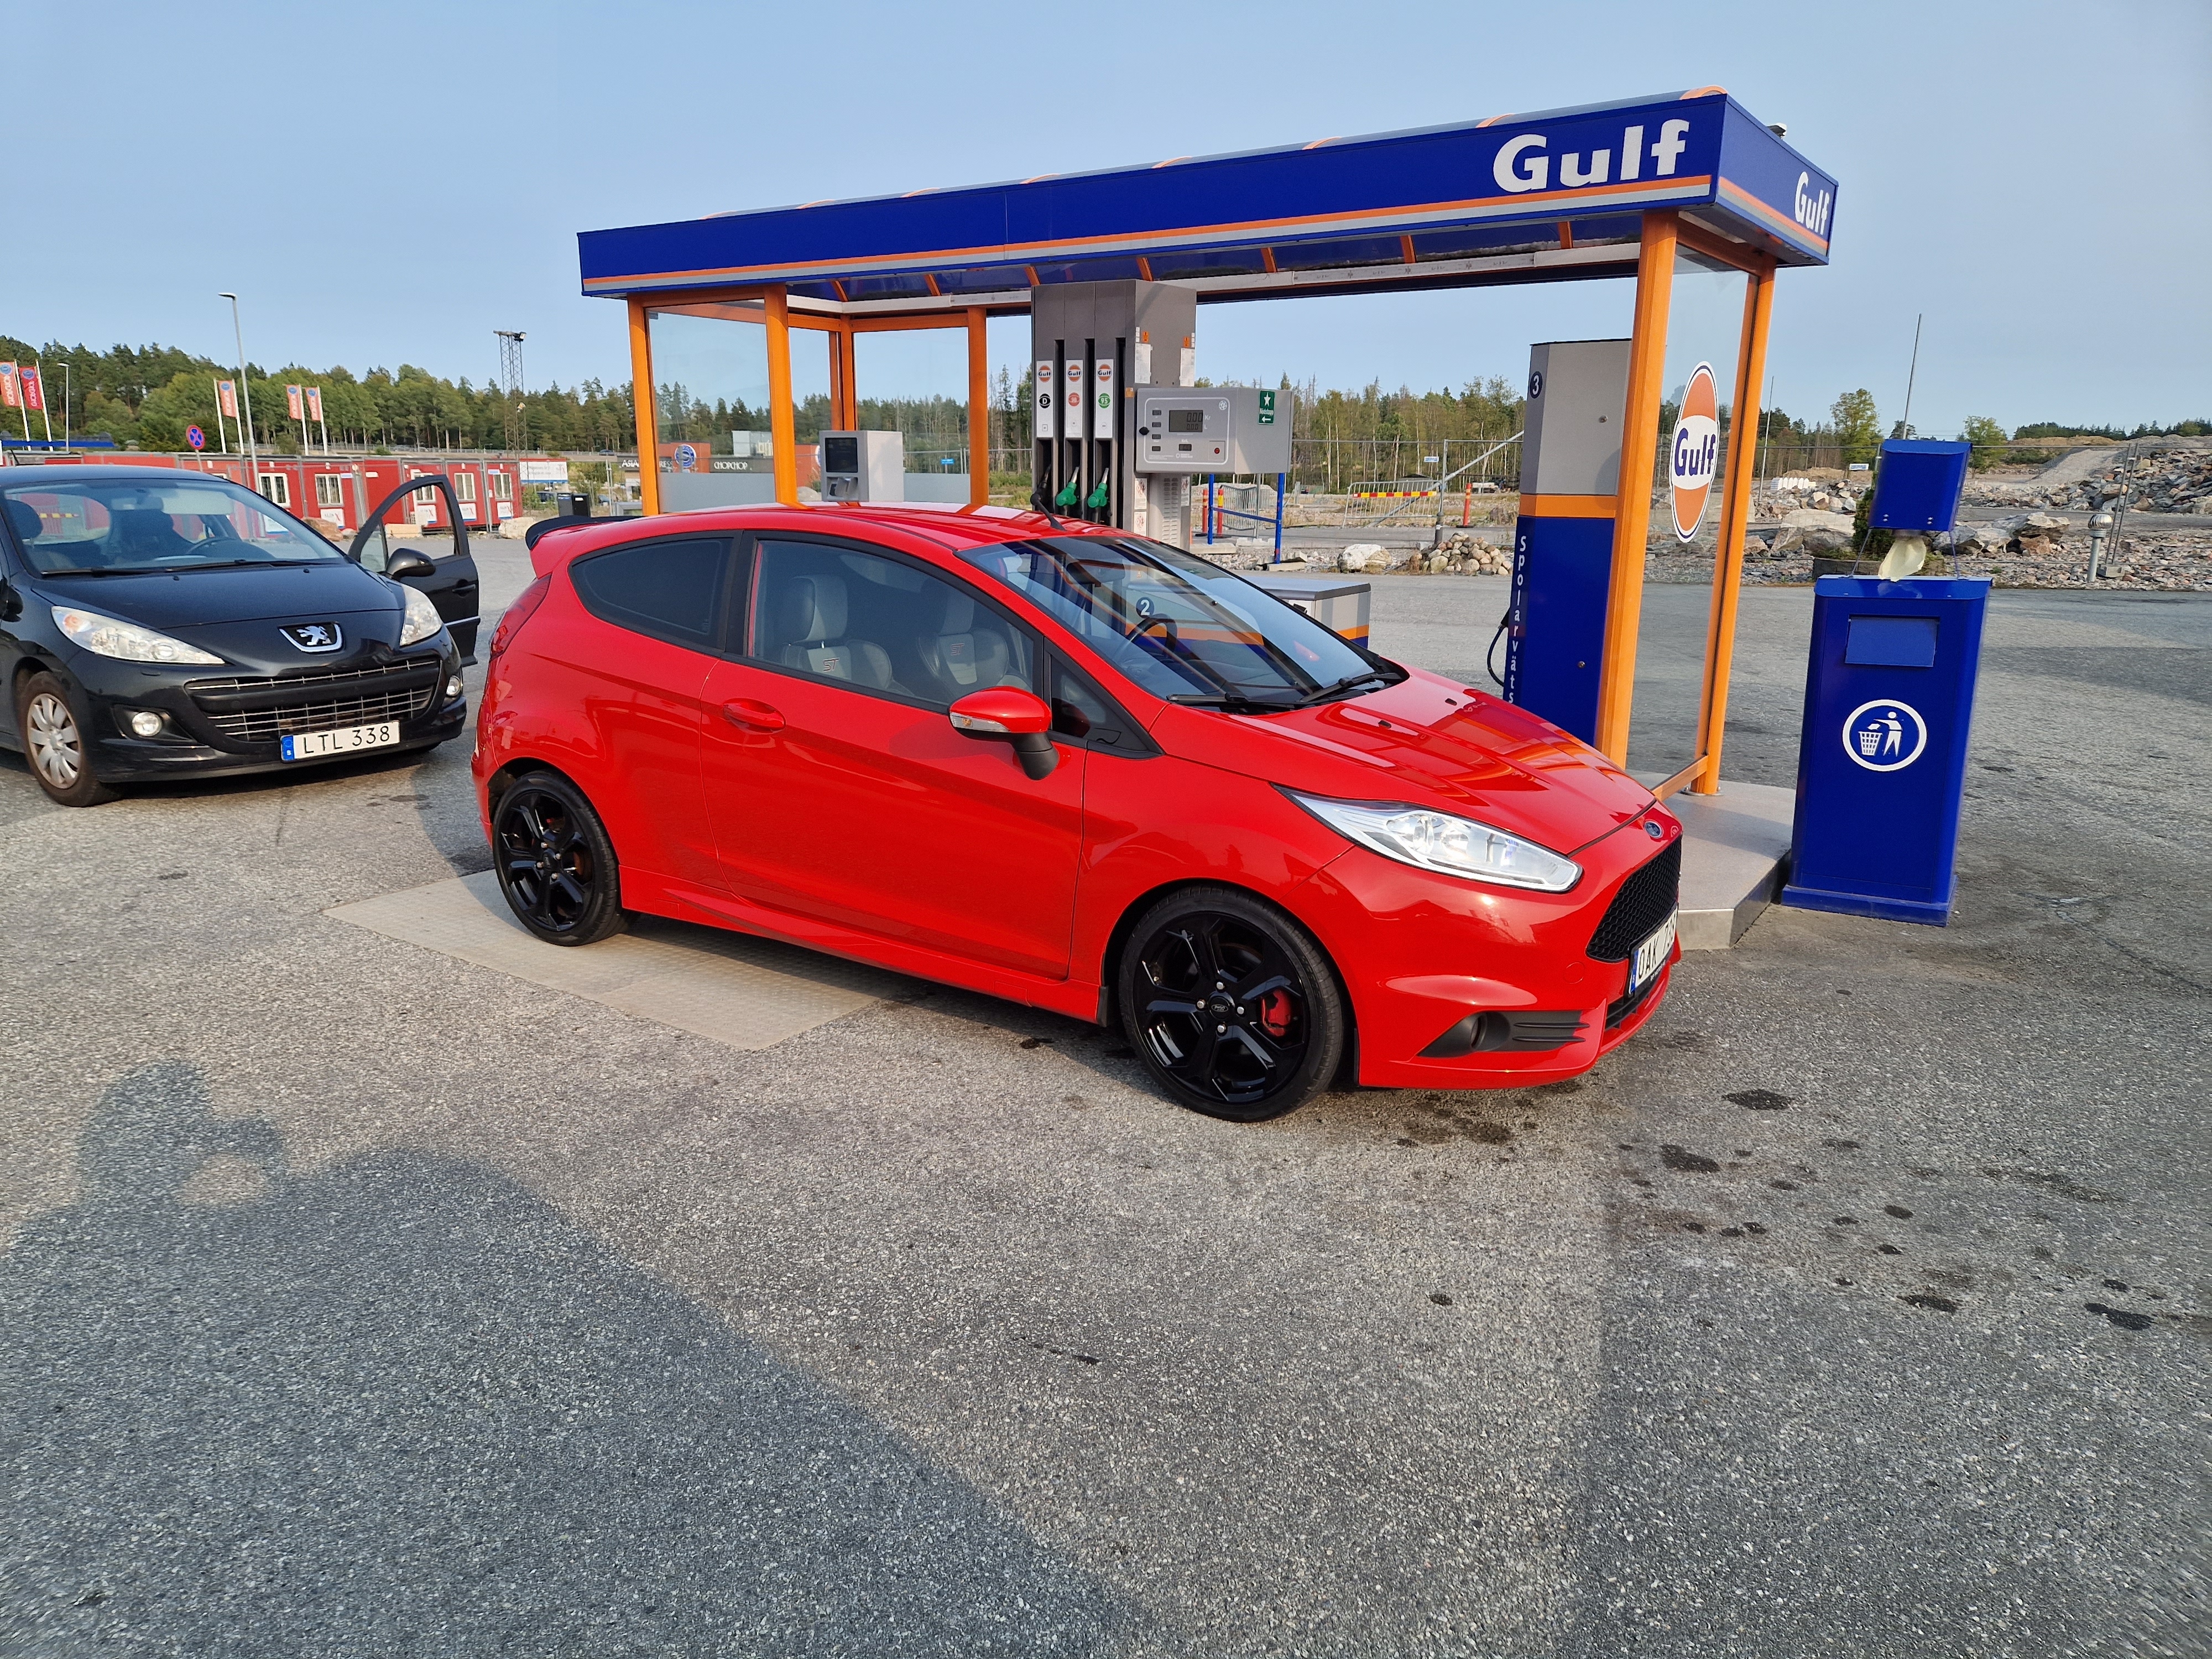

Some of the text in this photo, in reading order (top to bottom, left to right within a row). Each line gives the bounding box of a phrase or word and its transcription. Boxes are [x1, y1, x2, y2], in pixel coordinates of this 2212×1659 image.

[1493, 119, 1689, 193] Gulf
[1794, 171, 1830, 236] Gulf
[1532, 374, 1540, 395] 3
[622, 460, 640, 468] ASIA
[1674, 427, 1716, 477] Gulf
[713, 461, 748, 470] CHOPCHOP
[1140, 599, 1150, 616] 2
[1508, 535, 1527, 704] Spolarväts
[951, 643, 965, 656] ST
[823, 658, 839, 672] ST
[304, 726, 390, 754] LTL 338
[1638, 935, 1660, 979] OAK
